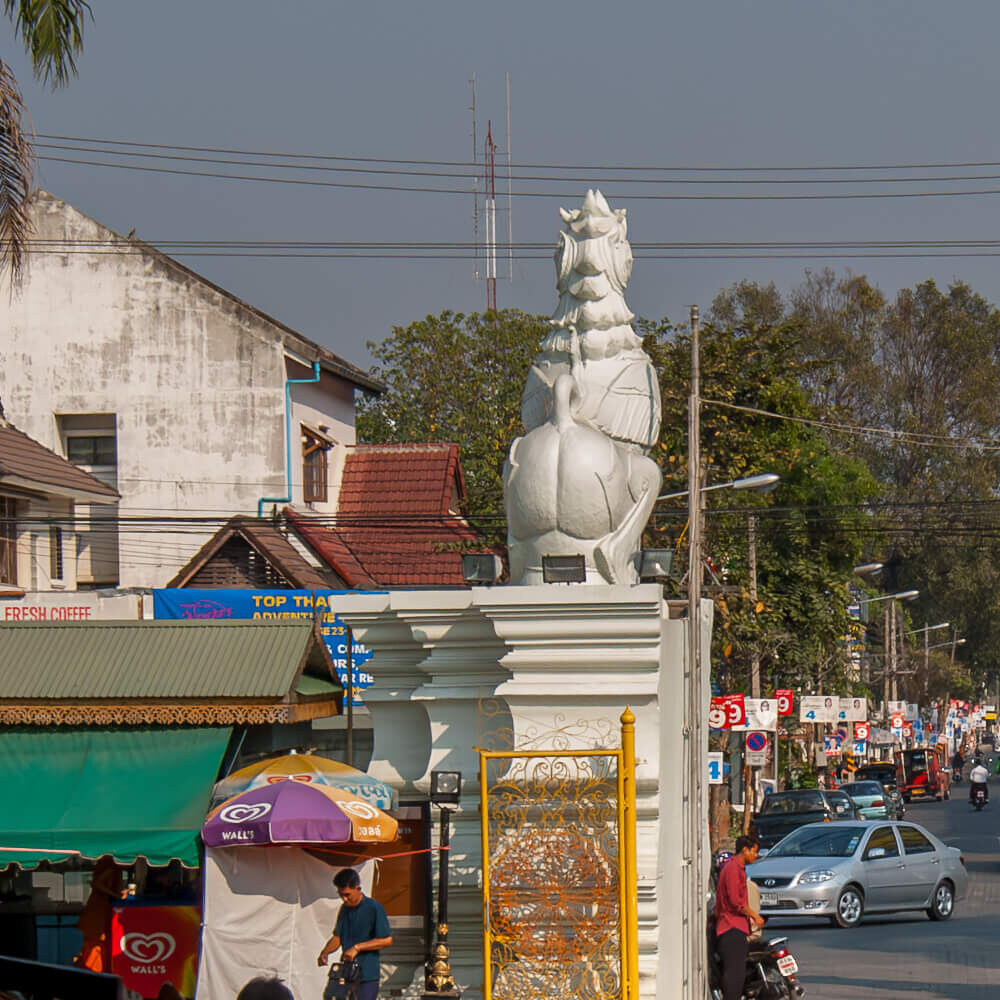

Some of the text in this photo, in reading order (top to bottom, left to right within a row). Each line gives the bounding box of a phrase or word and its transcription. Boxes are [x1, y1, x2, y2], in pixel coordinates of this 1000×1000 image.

[252, 596, 330, 607] TOP THA
[778, 697, 789, 712] 9
[709, 709, 726, 728] 9
[806, 710, 816, 720] 4
[893, 717, 903, 727] 9
[857, 727, 868, 738] 9
[130, 965, 167, 974] WALL'S
